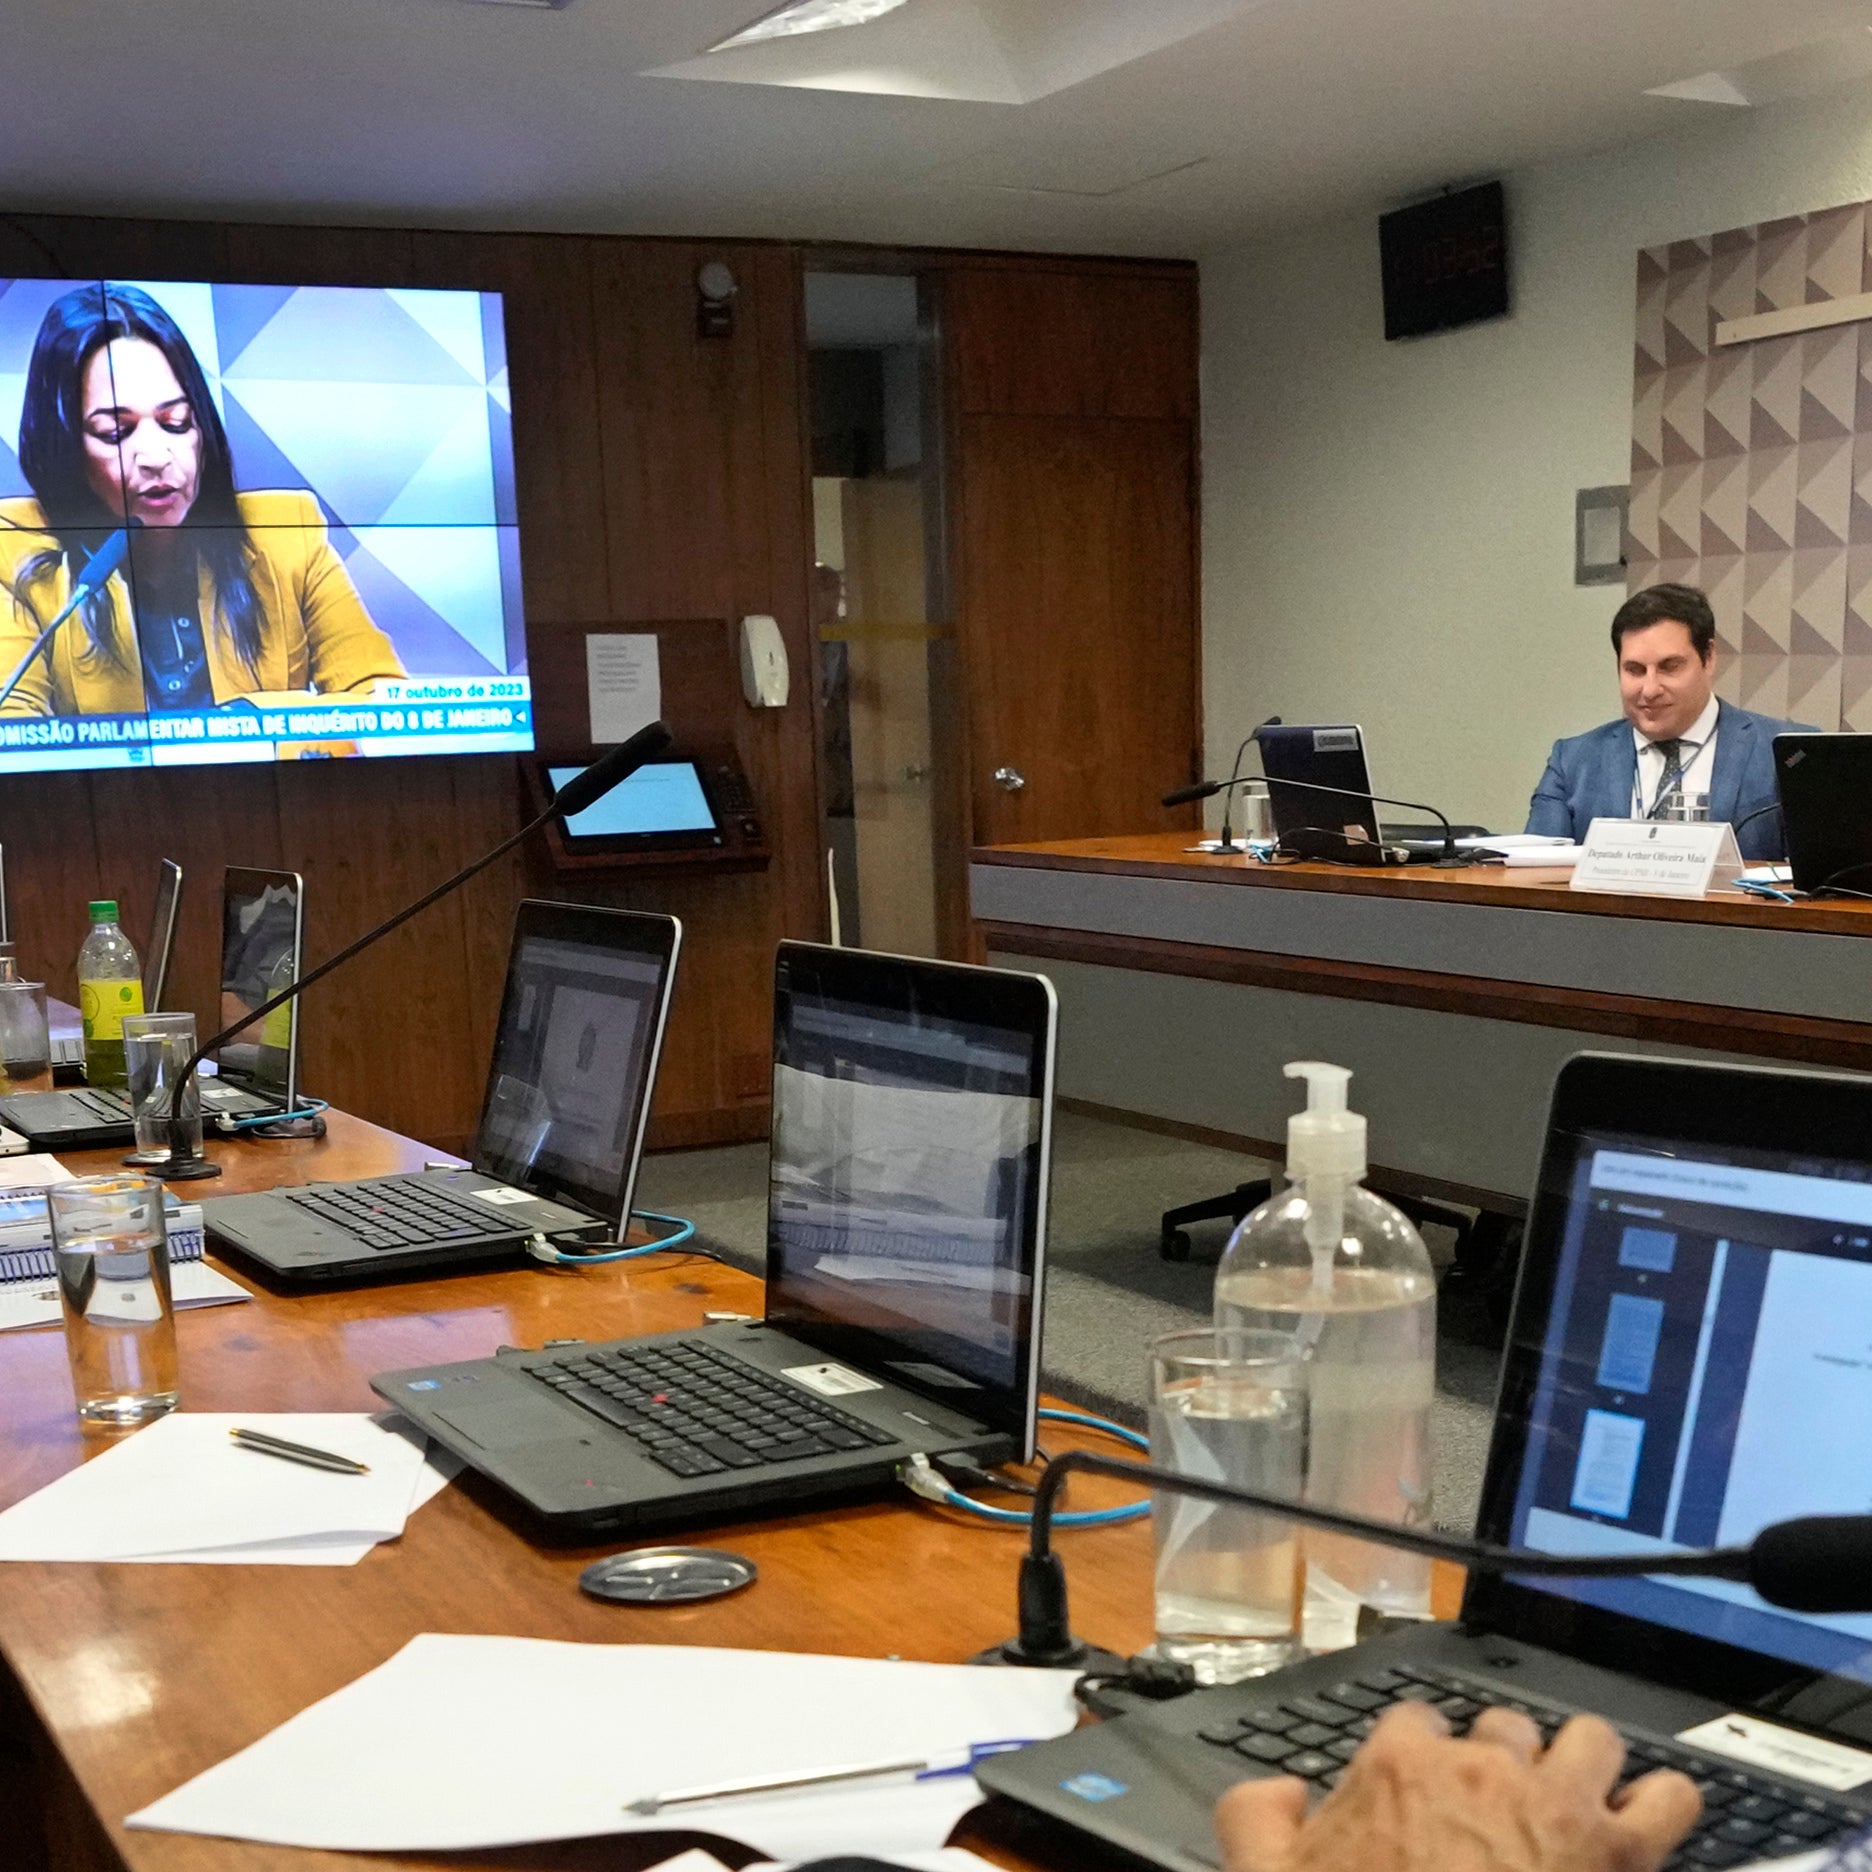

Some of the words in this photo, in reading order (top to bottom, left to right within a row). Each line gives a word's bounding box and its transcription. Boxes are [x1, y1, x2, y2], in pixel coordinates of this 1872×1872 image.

[387, 686, 401, 699] 17
[406, 684, 462, 699] outubro
[467, 683, 484, 697] de
[489, 682, 524, 697] 2023
[77, 715, 204, 743] PARLAMENTAR
[207, 713, 261, 738] MISTA
[262, 713, 287, 736] DE
[289, 708, 377, 736] INQUÉRITO
[380, 711, 404, 731] DO
[421, 708, 445, 730] DE
[446, 706, 513, 729] JANEIRO
